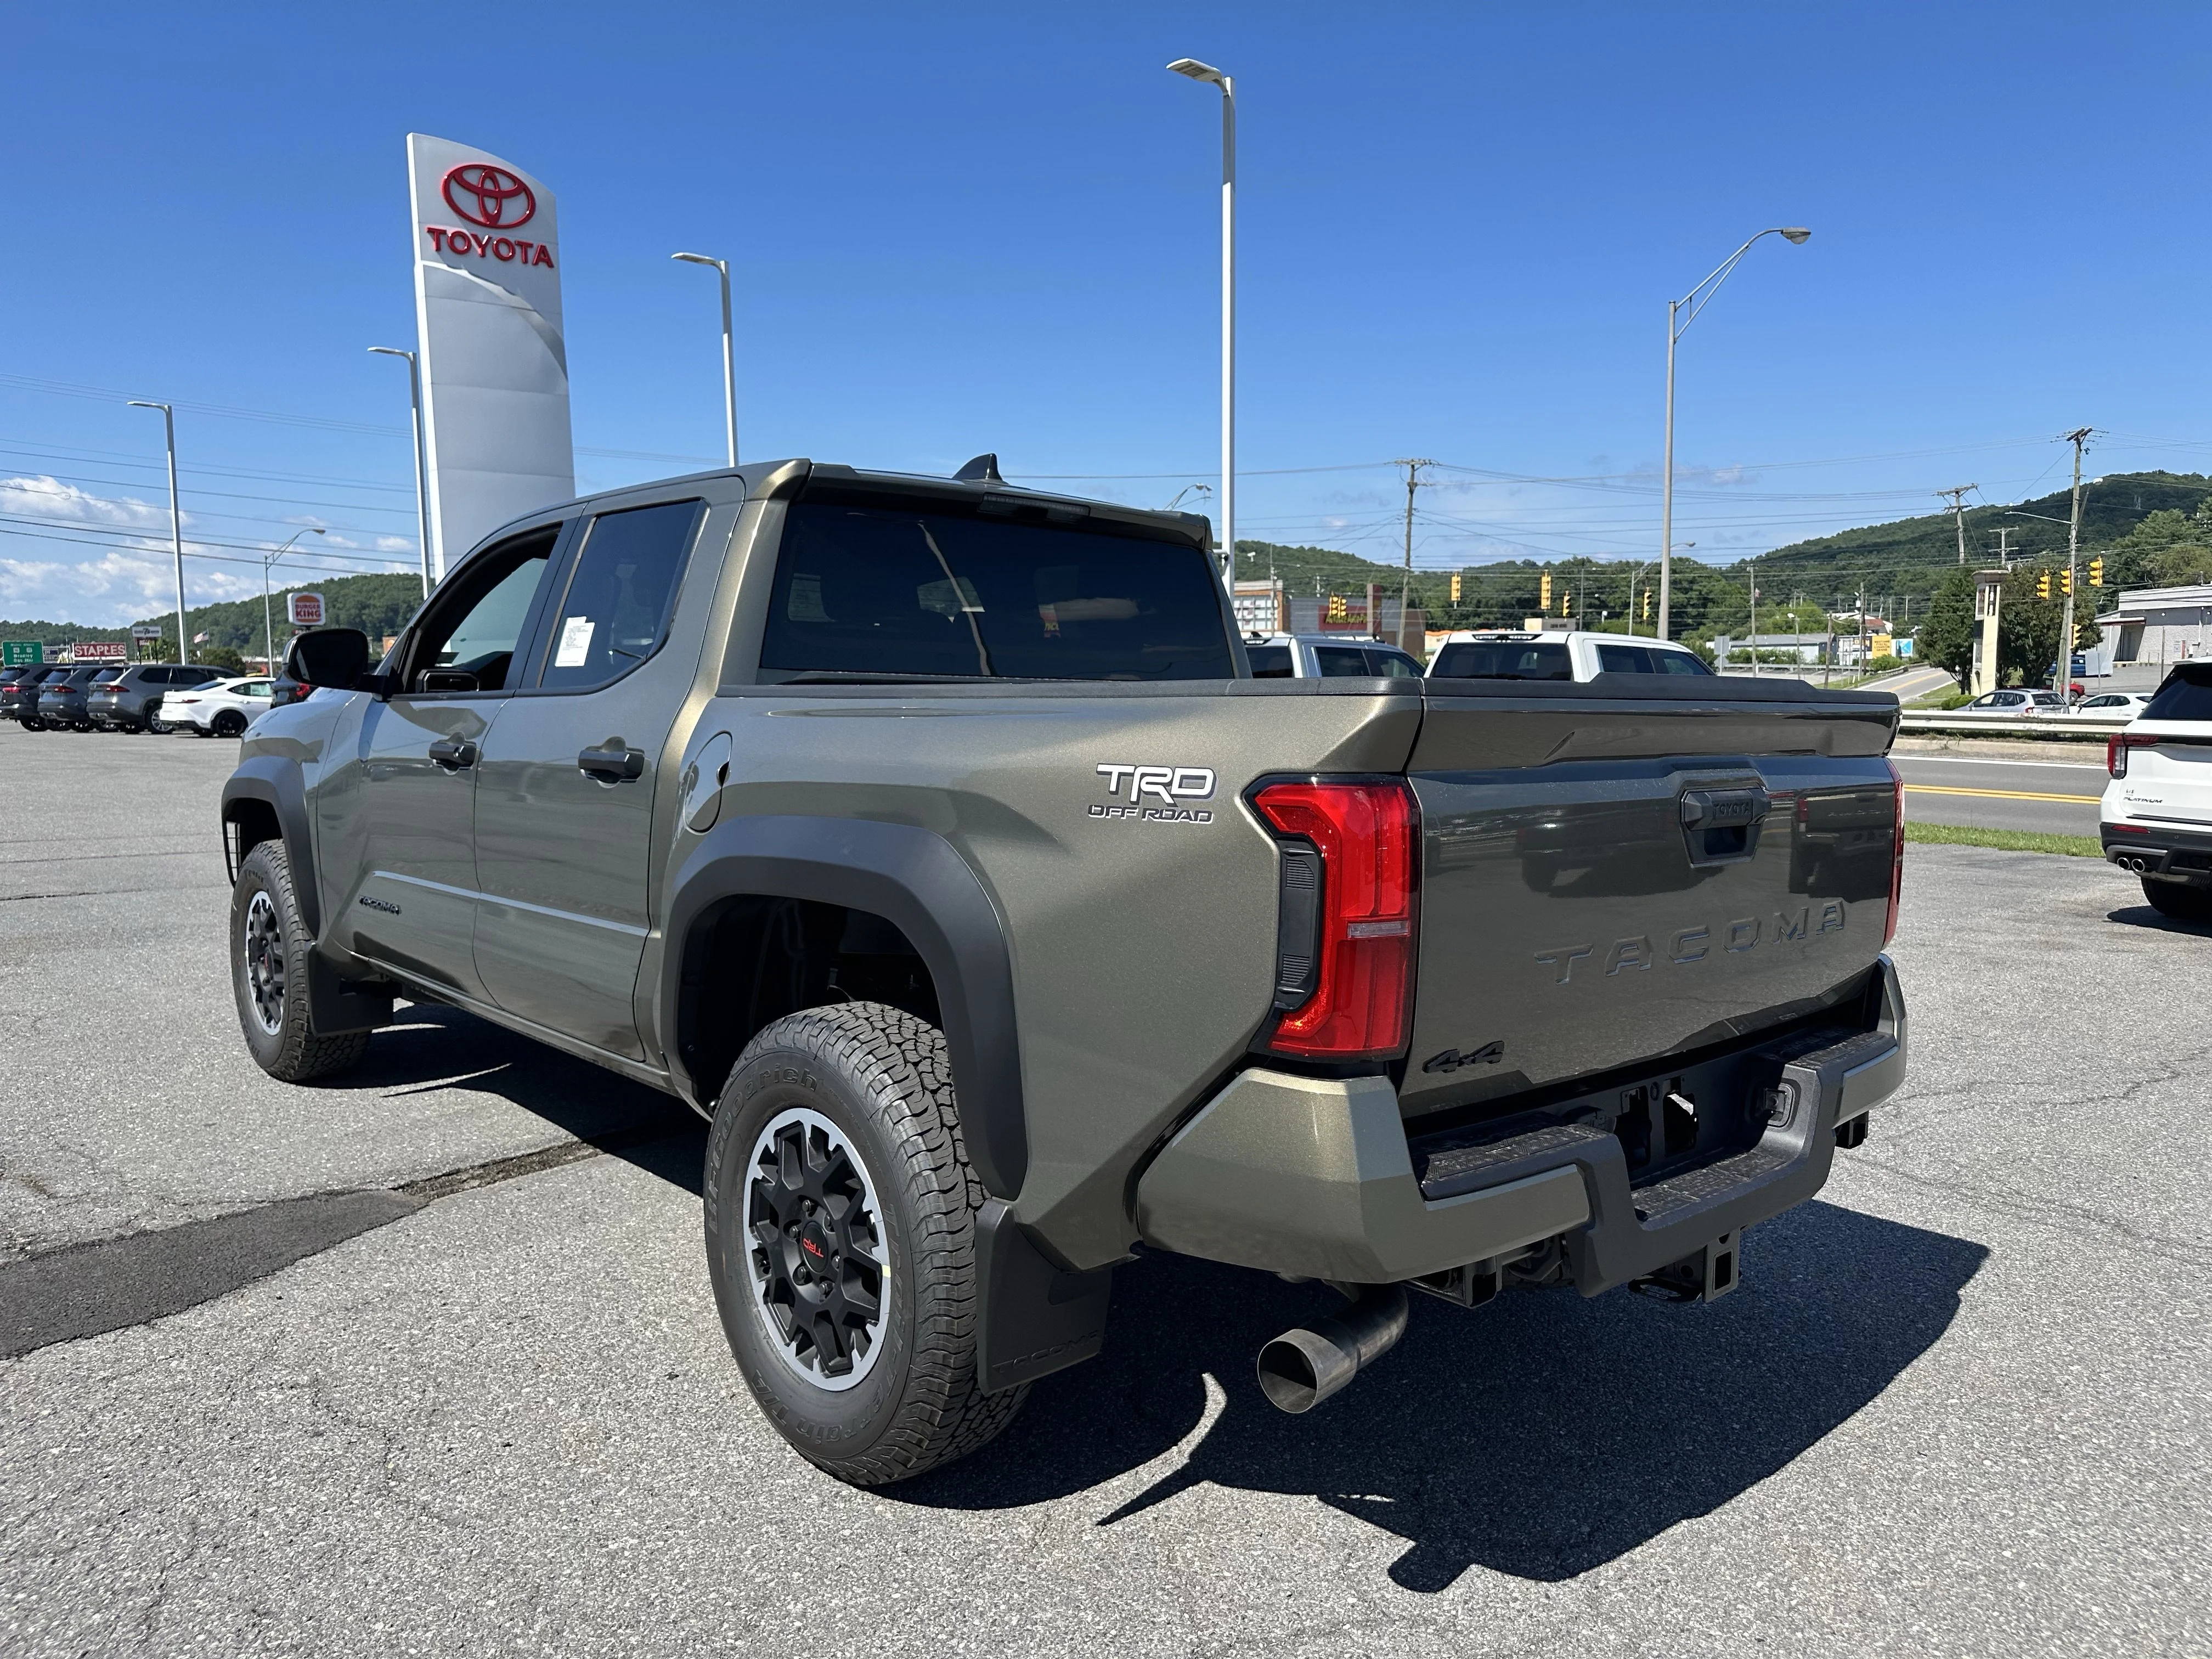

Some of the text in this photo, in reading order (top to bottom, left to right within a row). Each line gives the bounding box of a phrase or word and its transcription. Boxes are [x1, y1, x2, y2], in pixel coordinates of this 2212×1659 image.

[426, 225, 555, 268] TOYOTA
[75, 645, 126, 656] STAPLES
[1096, 763, 1217, 807] TRD
[1088, 805, 1214, 824] OFF ROAD
[1534, 898, 1846, 985] TACOMA
[708, 1063, 818, 1235] BFGoodrich
[803, 1237, 825, 1259] TRD
[991, 1329, 1101, 1374] TACOMA
